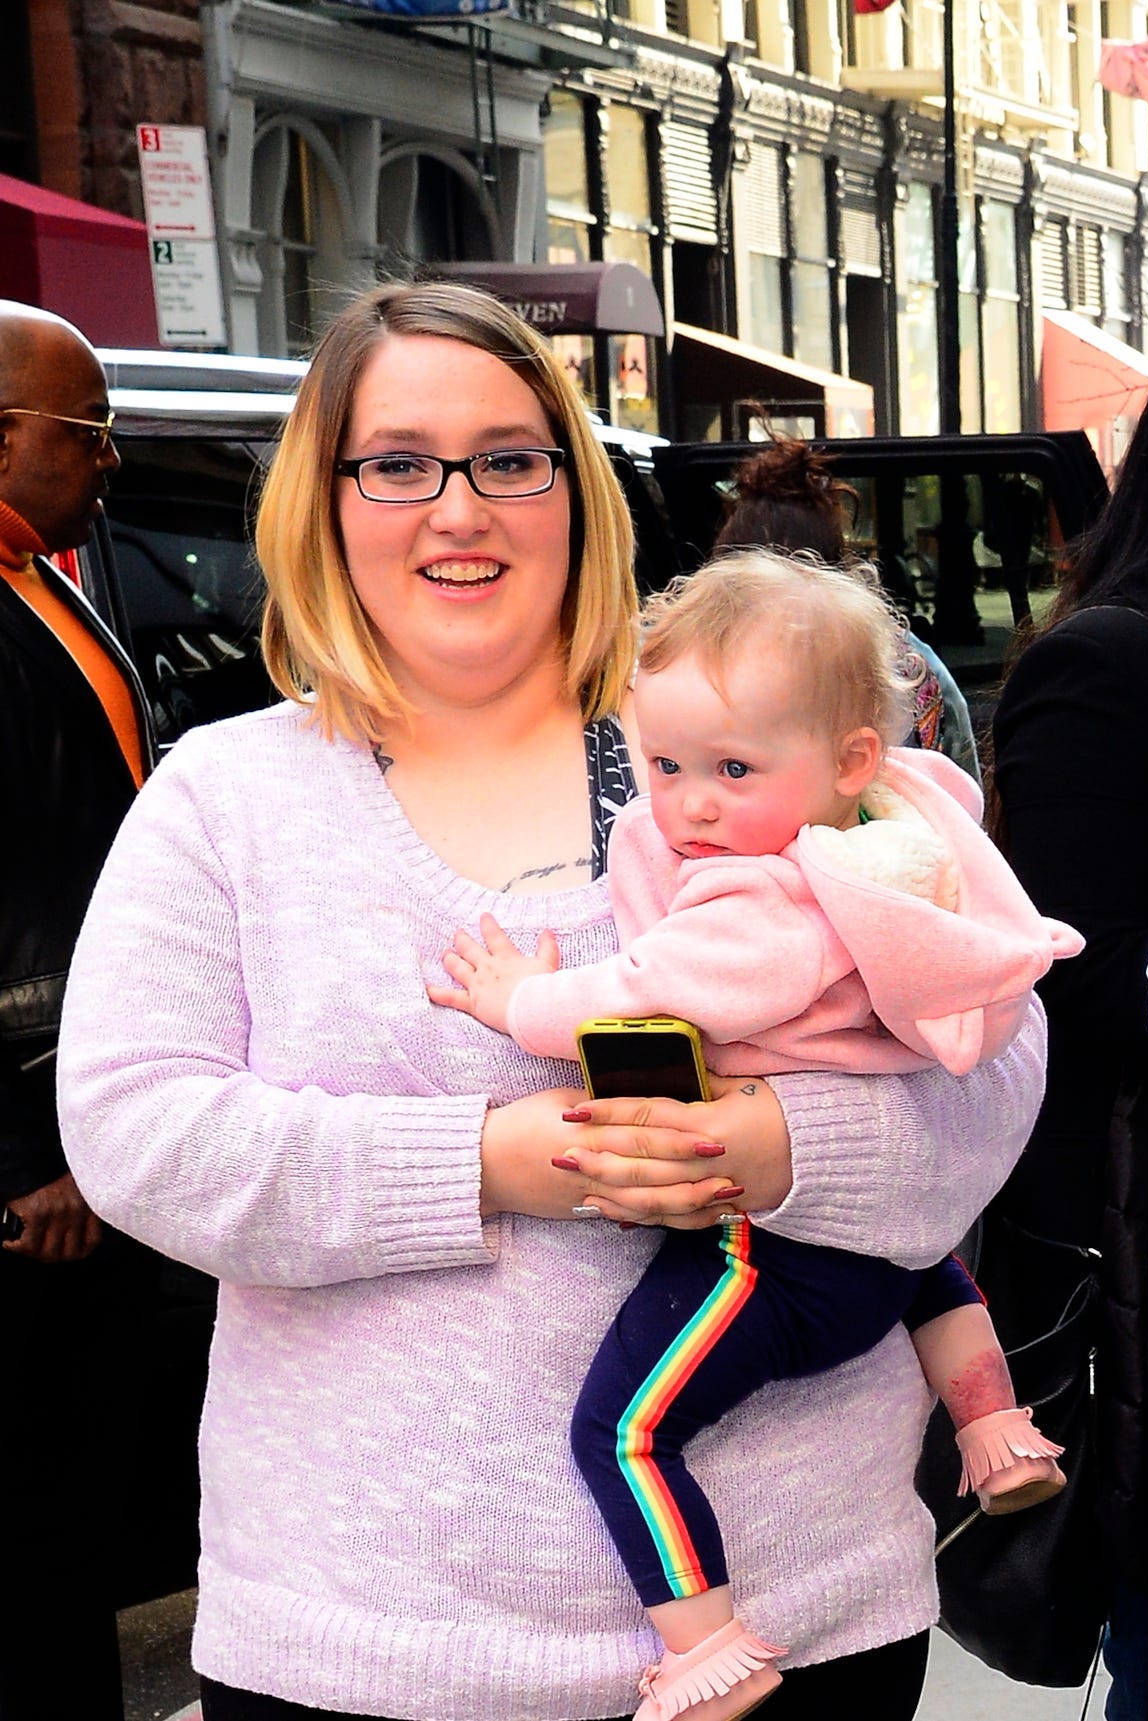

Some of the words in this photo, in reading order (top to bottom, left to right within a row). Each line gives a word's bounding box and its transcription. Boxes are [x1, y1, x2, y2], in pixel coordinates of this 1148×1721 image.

[143, 129, 157, 151] 3
[156, 241, 170, 264] 2
[513, 301, 567, 322] VEN
